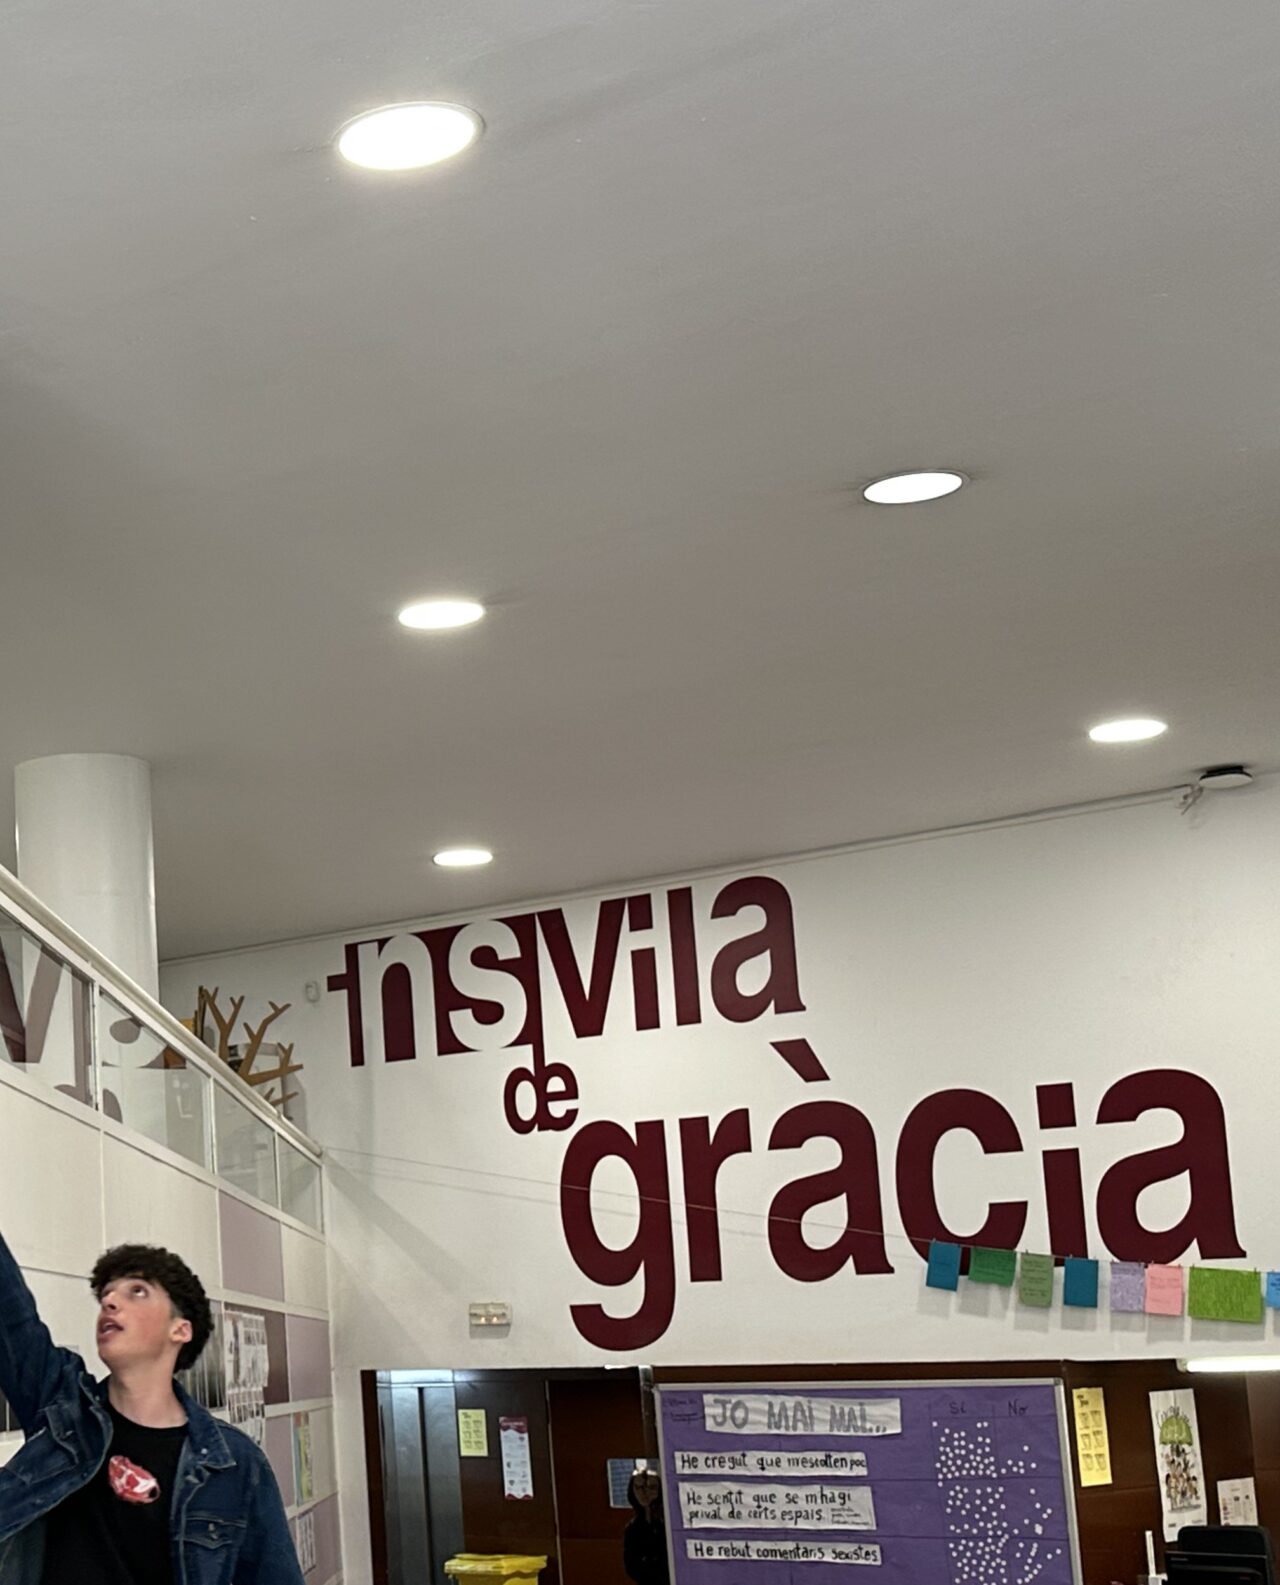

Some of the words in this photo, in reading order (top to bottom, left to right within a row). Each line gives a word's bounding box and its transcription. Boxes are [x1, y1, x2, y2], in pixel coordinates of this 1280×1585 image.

[560, 1038, 1247, 1352] gràcia
[712, 1399, 749, 1430] JO
[681, 1453, 699, 1470] He
[705, 1452, 748, 1470] cregut
[757, 1456, 781, 1471] que
[687, 1490, 702, 1505] He
[707, 1490, 744, 1506] sentit
[753, 1493, 777, 1509] que
[785, 1492, 799, 1505] se
[728, 1504, 742, 1520] de
[748, 1507, 777, 1520] certs
[694, 1542, 714, 1557] He
[718, 1541, 752, 1558] rebut
[756, 1542, 825, 1560] comentaris
